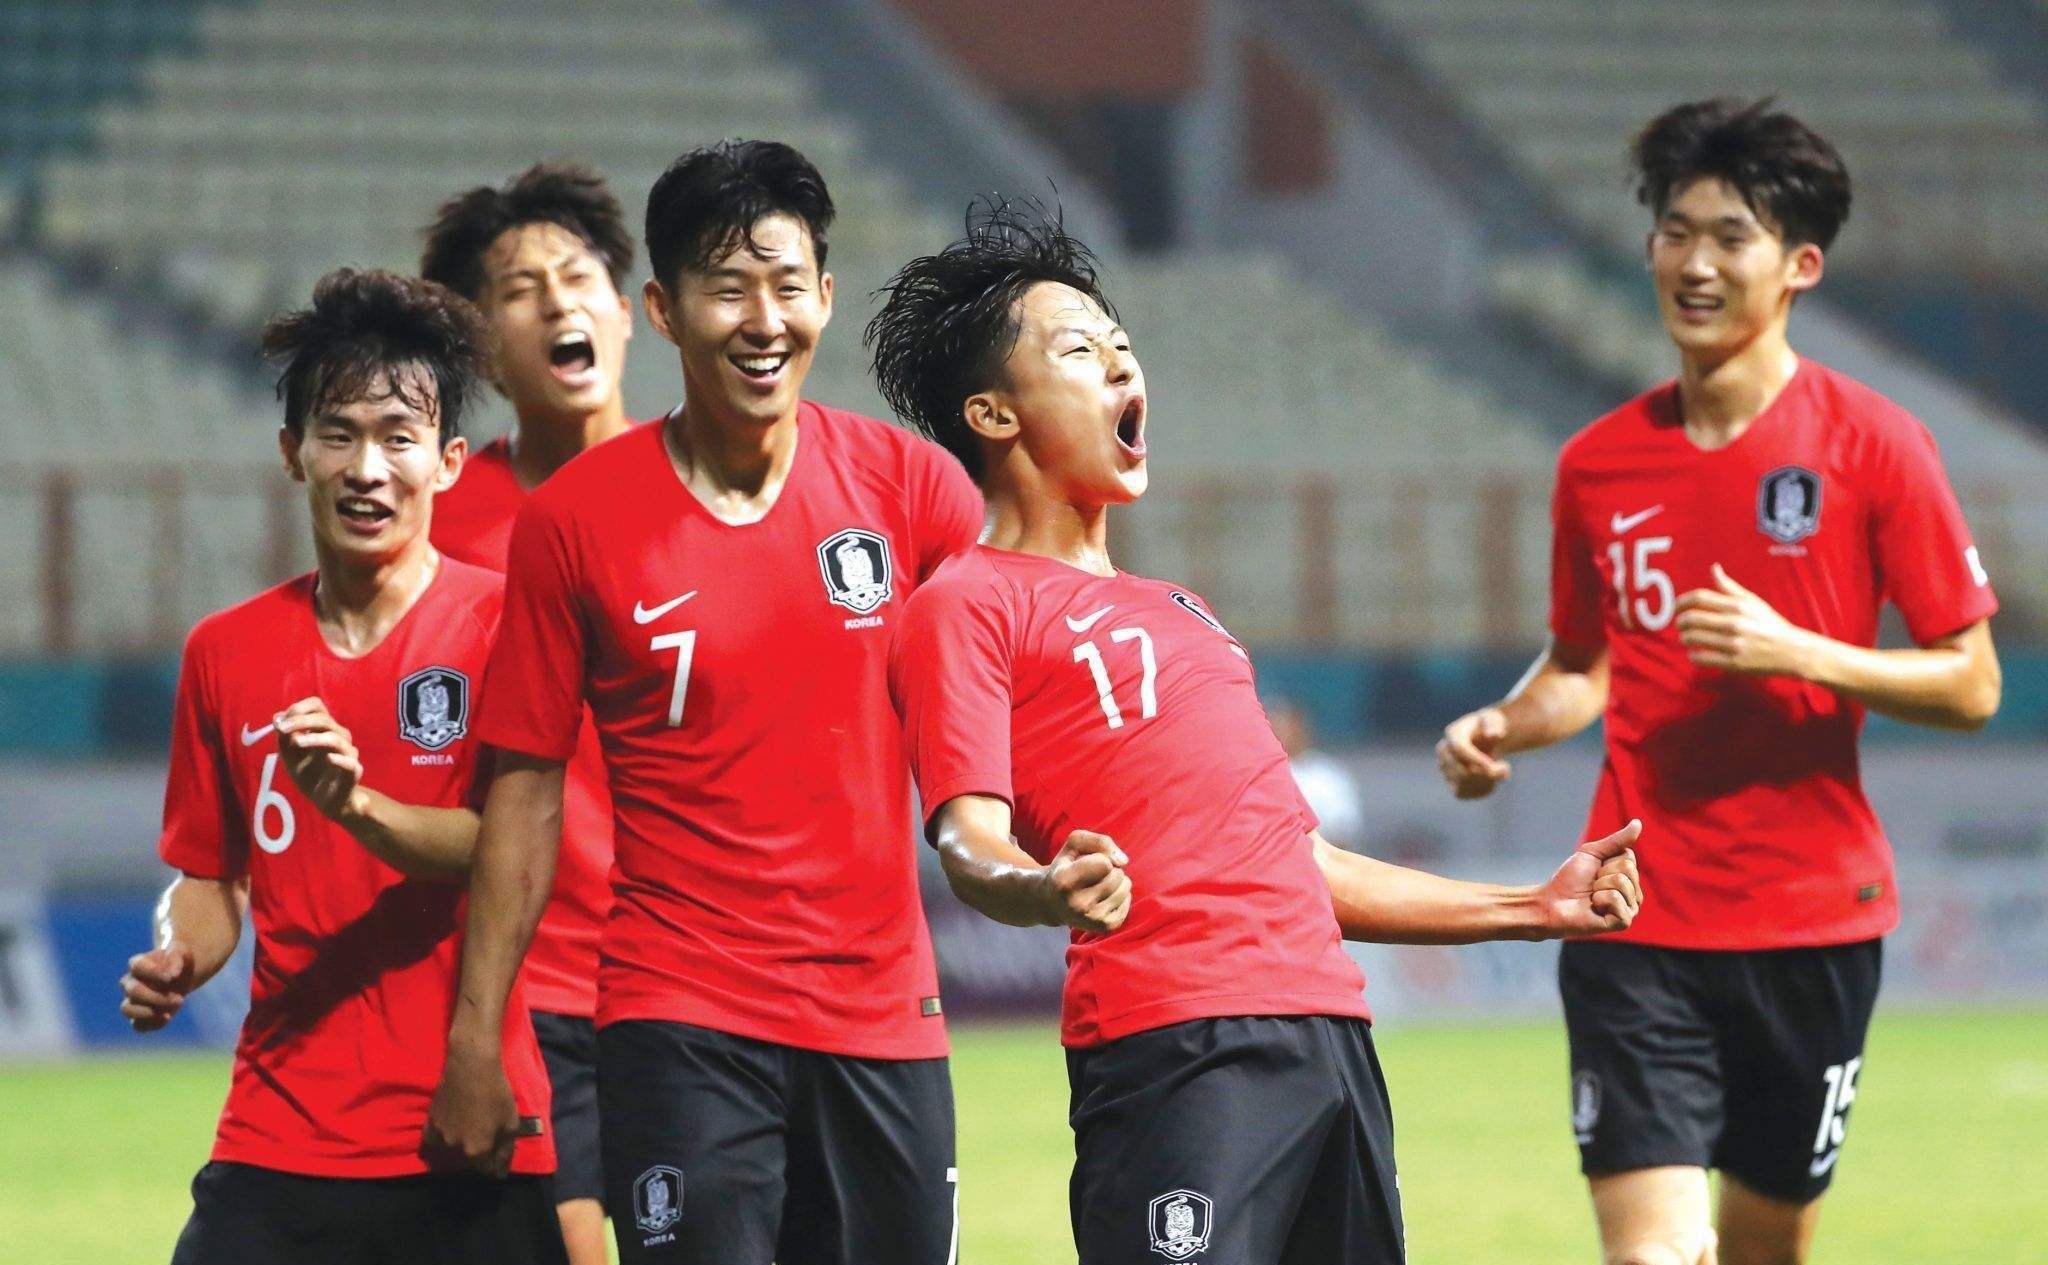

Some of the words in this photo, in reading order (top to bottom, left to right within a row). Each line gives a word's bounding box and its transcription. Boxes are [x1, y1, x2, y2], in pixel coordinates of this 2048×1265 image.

[844, 616, 885, 630] KOREA
[1607, 535, 1677, 631] 15
[650, 629, 697, 728] 7
[1072, 627, 1158, 729] 17
[254, 752, 296, 854] 6
[411, 754, 455, 766] KOREA
